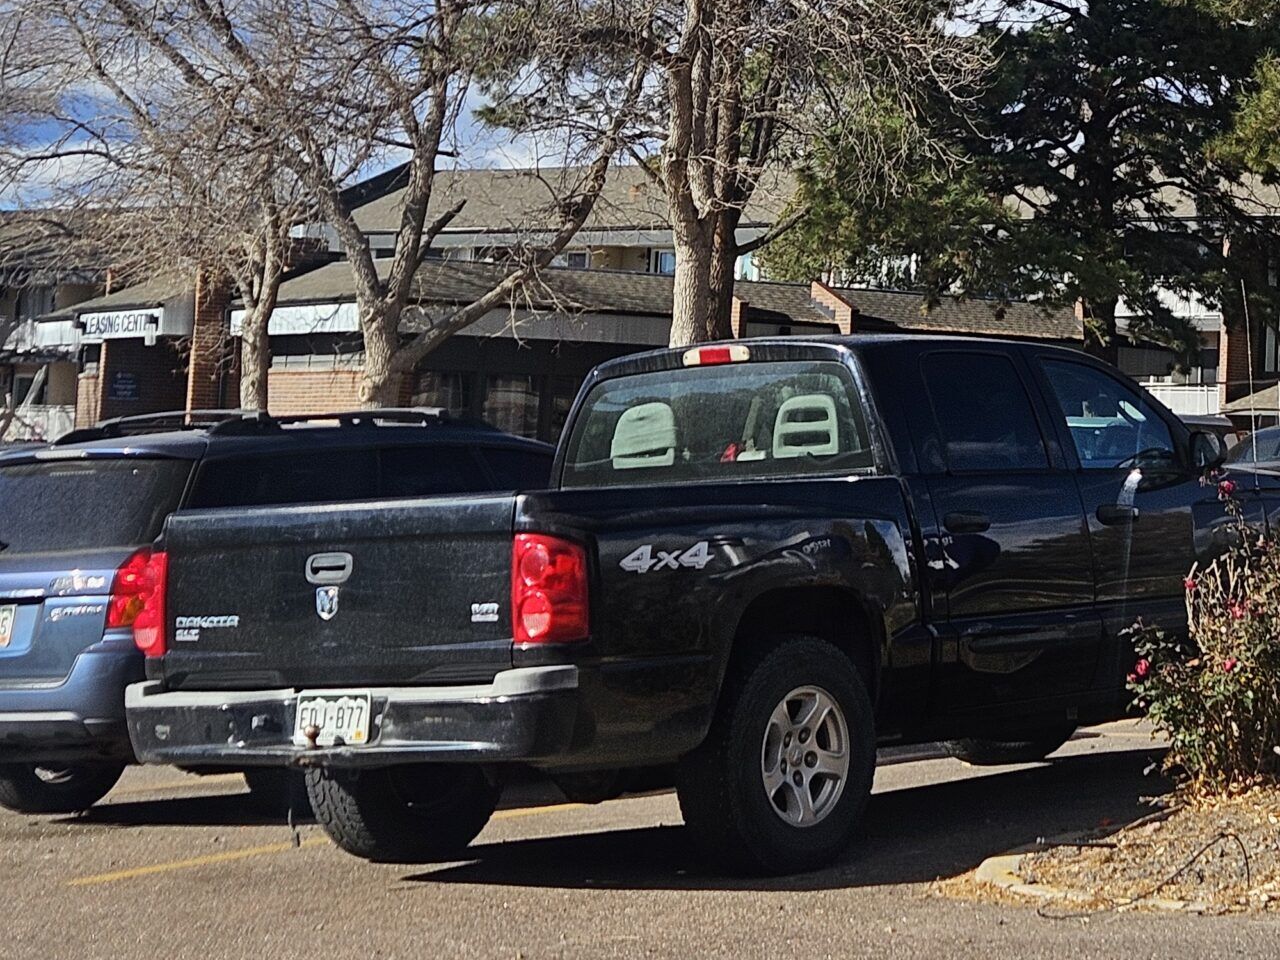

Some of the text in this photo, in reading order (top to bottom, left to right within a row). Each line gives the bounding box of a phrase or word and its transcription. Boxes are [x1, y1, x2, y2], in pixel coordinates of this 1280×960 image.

[85, 314, 120, 334] LEASING
[619, 541, 715, 573] 4x4
[176, 615, 239, 628] DAKOTA
